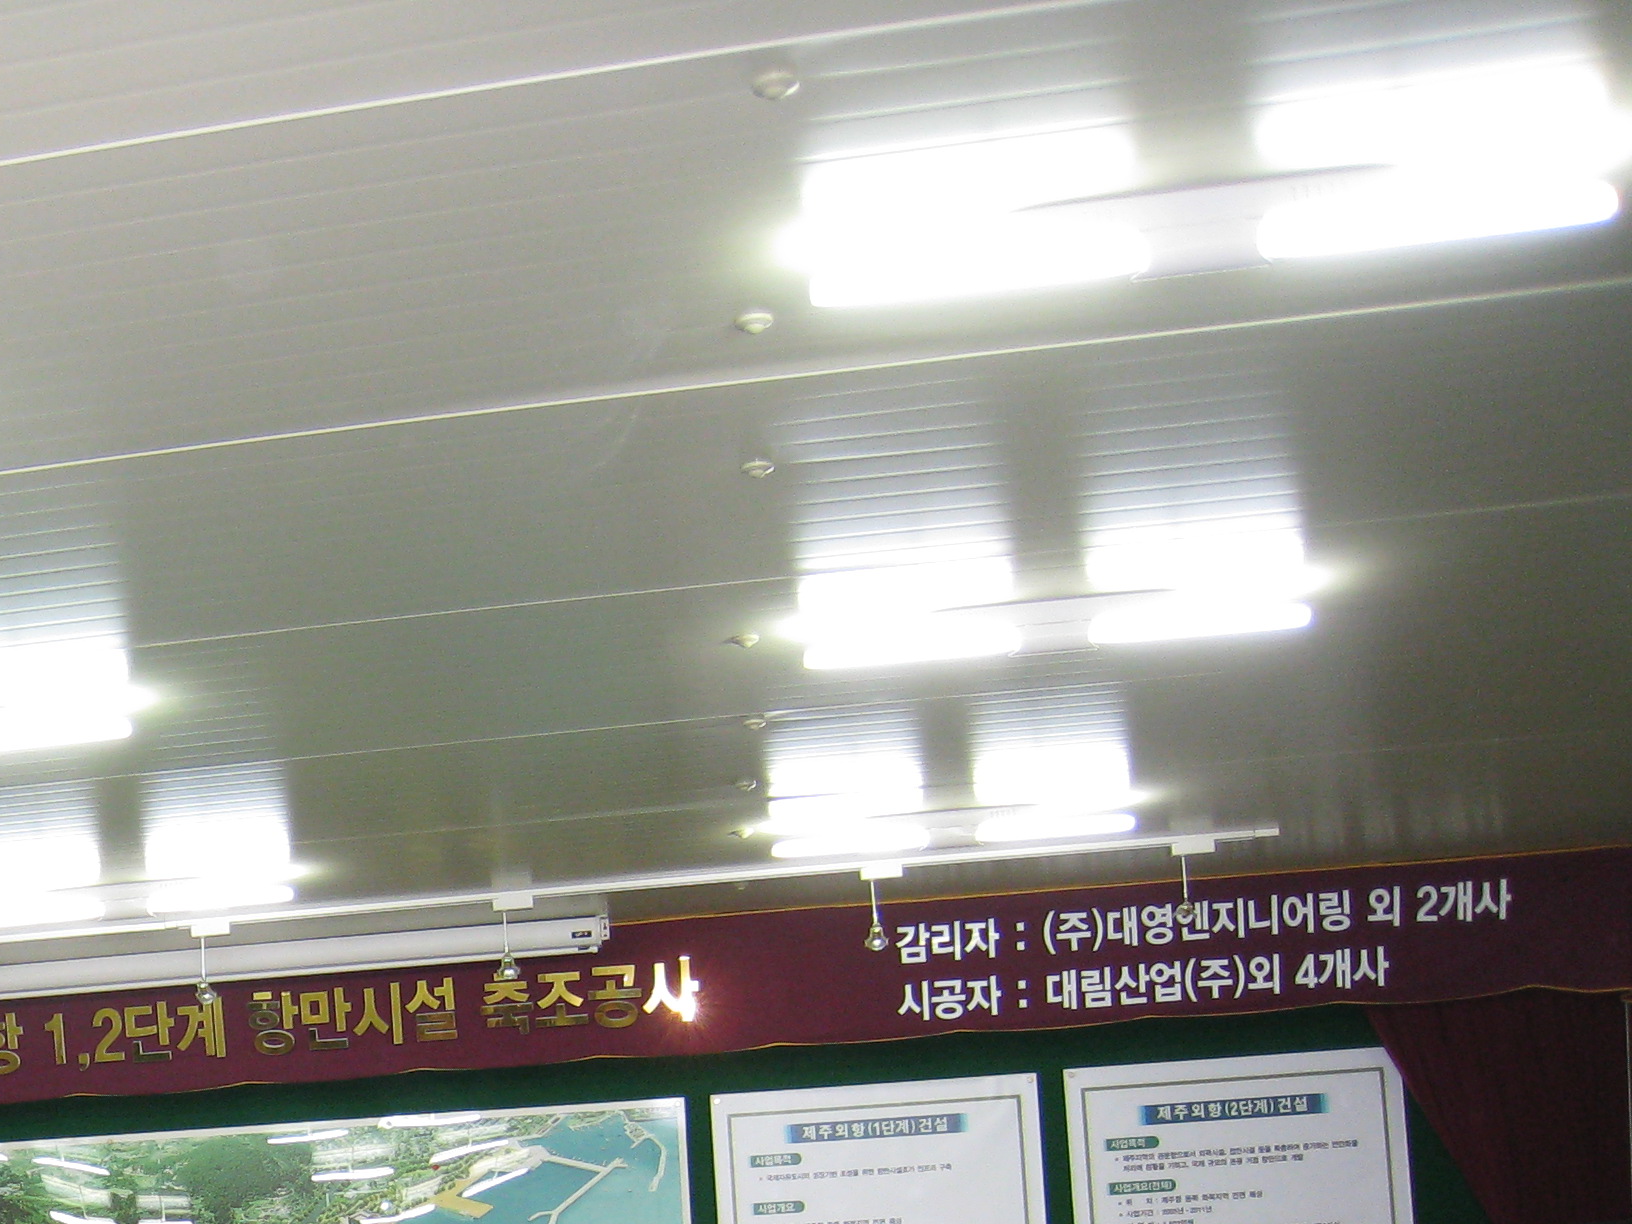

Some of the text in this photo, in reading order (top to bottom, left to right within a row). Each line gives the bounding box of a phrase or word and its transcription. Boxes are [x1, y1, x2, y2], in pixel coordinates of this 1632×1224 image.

[895, 918, 1000, 964] 감리자
[1043, 889, 1351, 955] (주)대영엔지니어링
[1368, 886, 1400, 927] 외
[1416, 879, 1511, 922] 2개사
[897, 975, 1001, 1021] 시공자
[1046, 953, 1280, 1010] 대림산업(주)외
[1295, 946, 1389, 989] 4개사
[44, 997, 227, 1071] 1,2단계
[247, 977, 459, 1055] 항만시설
[480, 955, 701, 1034] 축조공사
[754, 1155, 791, 1166] 사업목적
[1111, 1138, 1146, 1149] 사업목적
[757, 1202, 795, 1213] 사업개요
